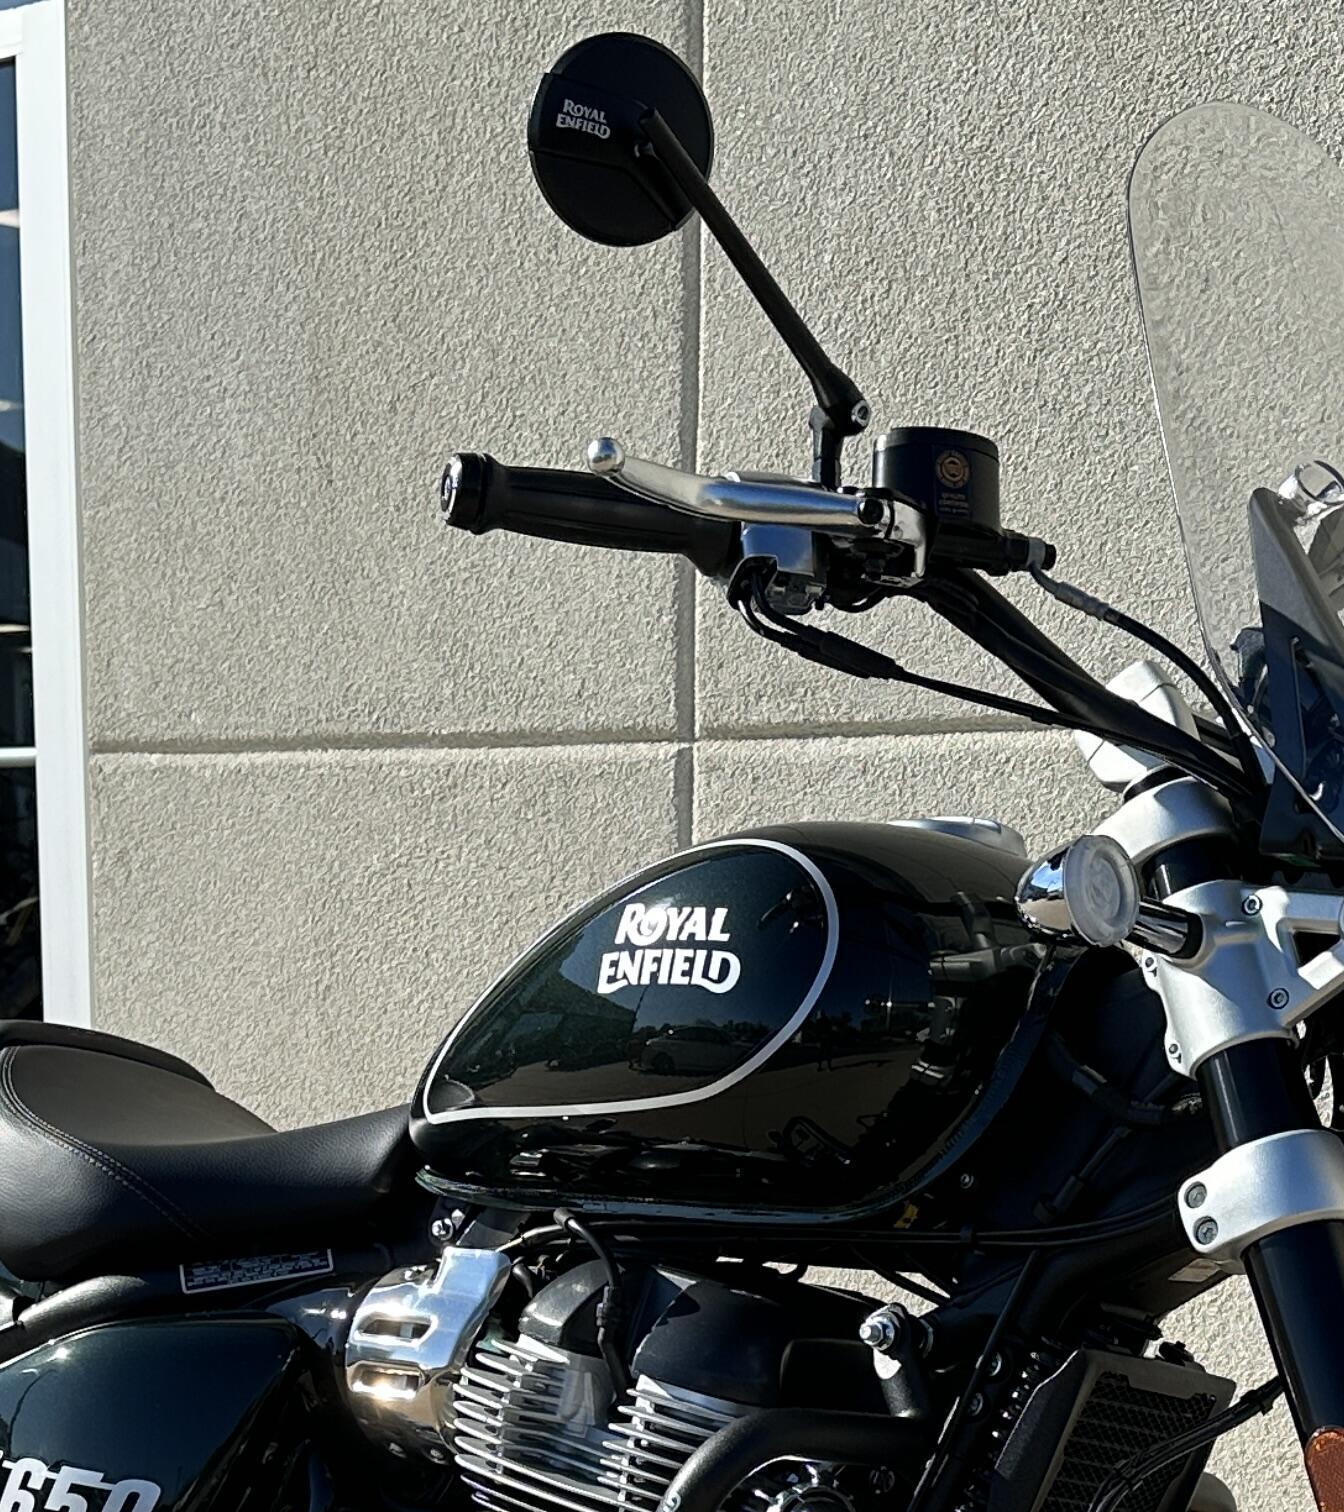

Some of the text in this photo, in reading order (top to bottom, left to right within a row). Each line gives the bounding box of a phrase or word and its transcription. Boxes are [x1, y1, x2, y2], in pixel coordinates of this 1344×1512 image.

[556, 113, 611, 139] ENFIELD
[562, 98, 607, 124] ROYAL
[614, 902, 731, 946] ROYAL
[597, 948, 741, 994] ENFIELD
